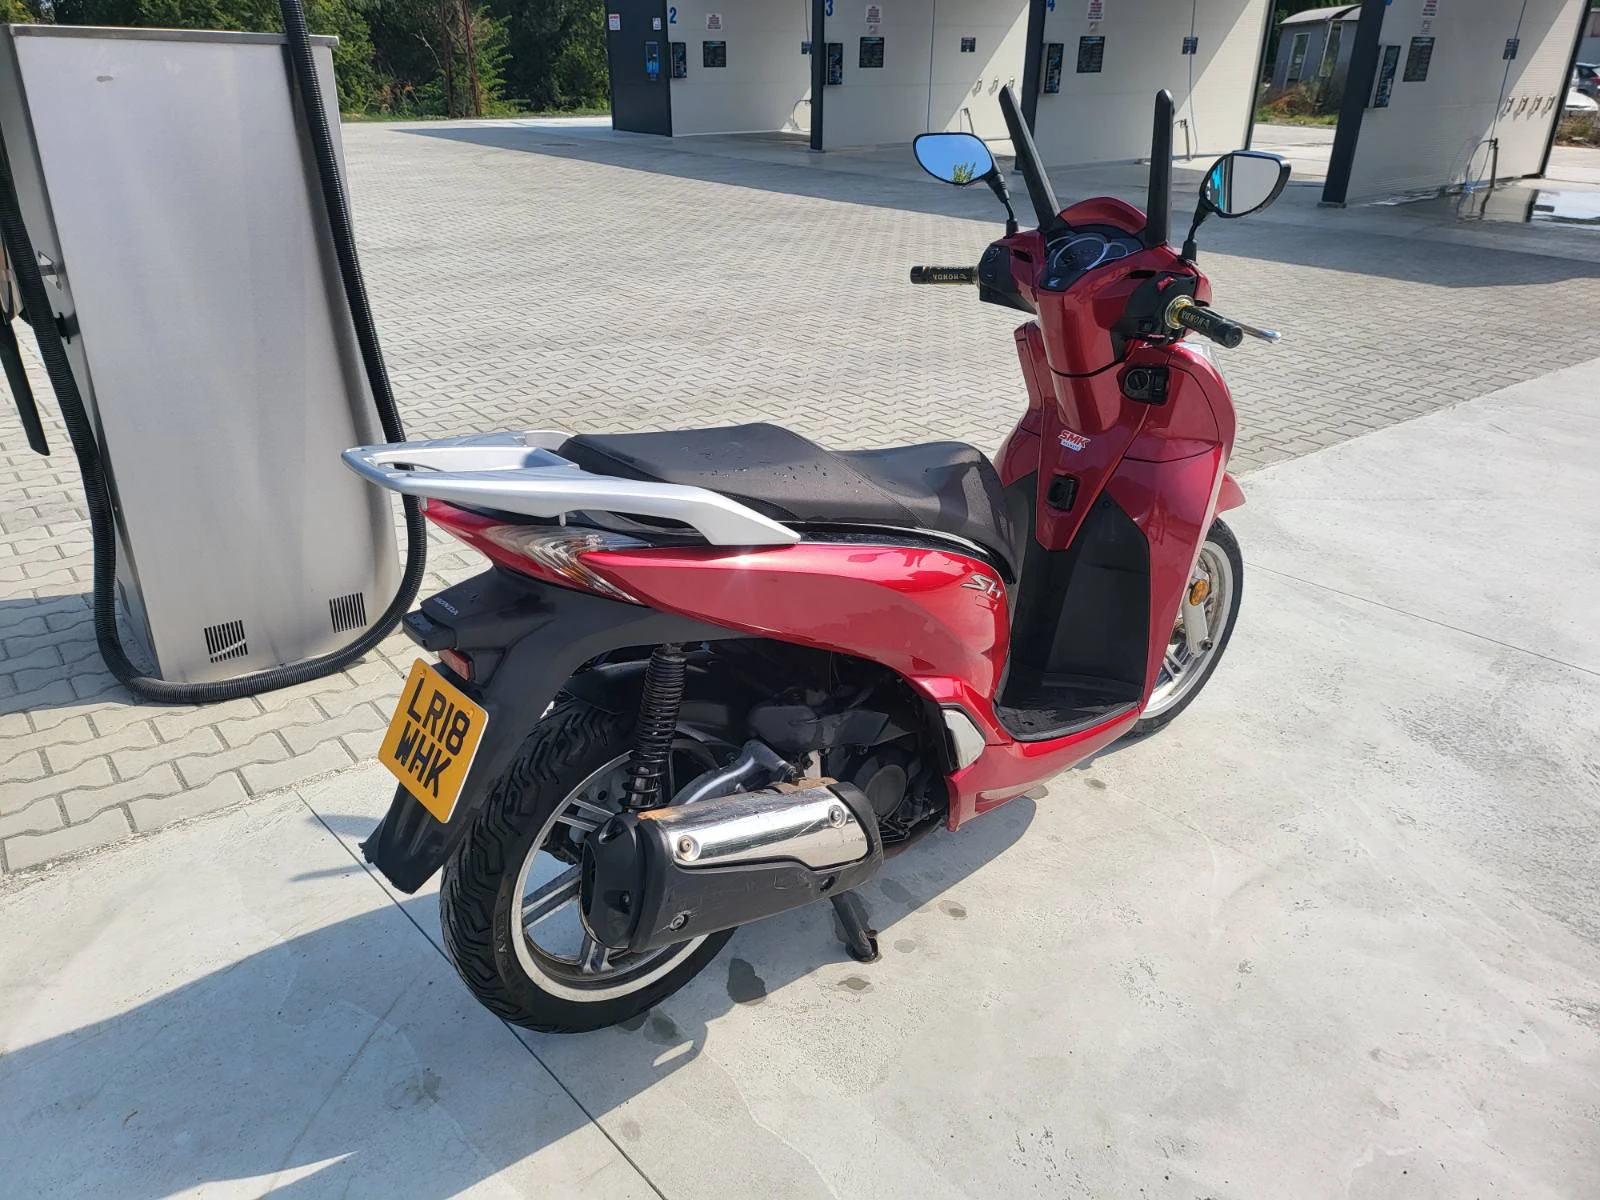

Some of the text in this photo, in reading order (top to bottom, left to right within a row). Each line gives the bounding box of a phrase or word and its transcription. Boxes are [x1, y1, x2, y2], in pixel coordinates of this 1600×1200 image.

[669, 7, 677, 24] 2
[825, 0, 833, 16] 3
[1059, 430, 1090, 448] SMK
[406, 677, 471, 756] LR18
[393, 719, 453, 799] WHK
